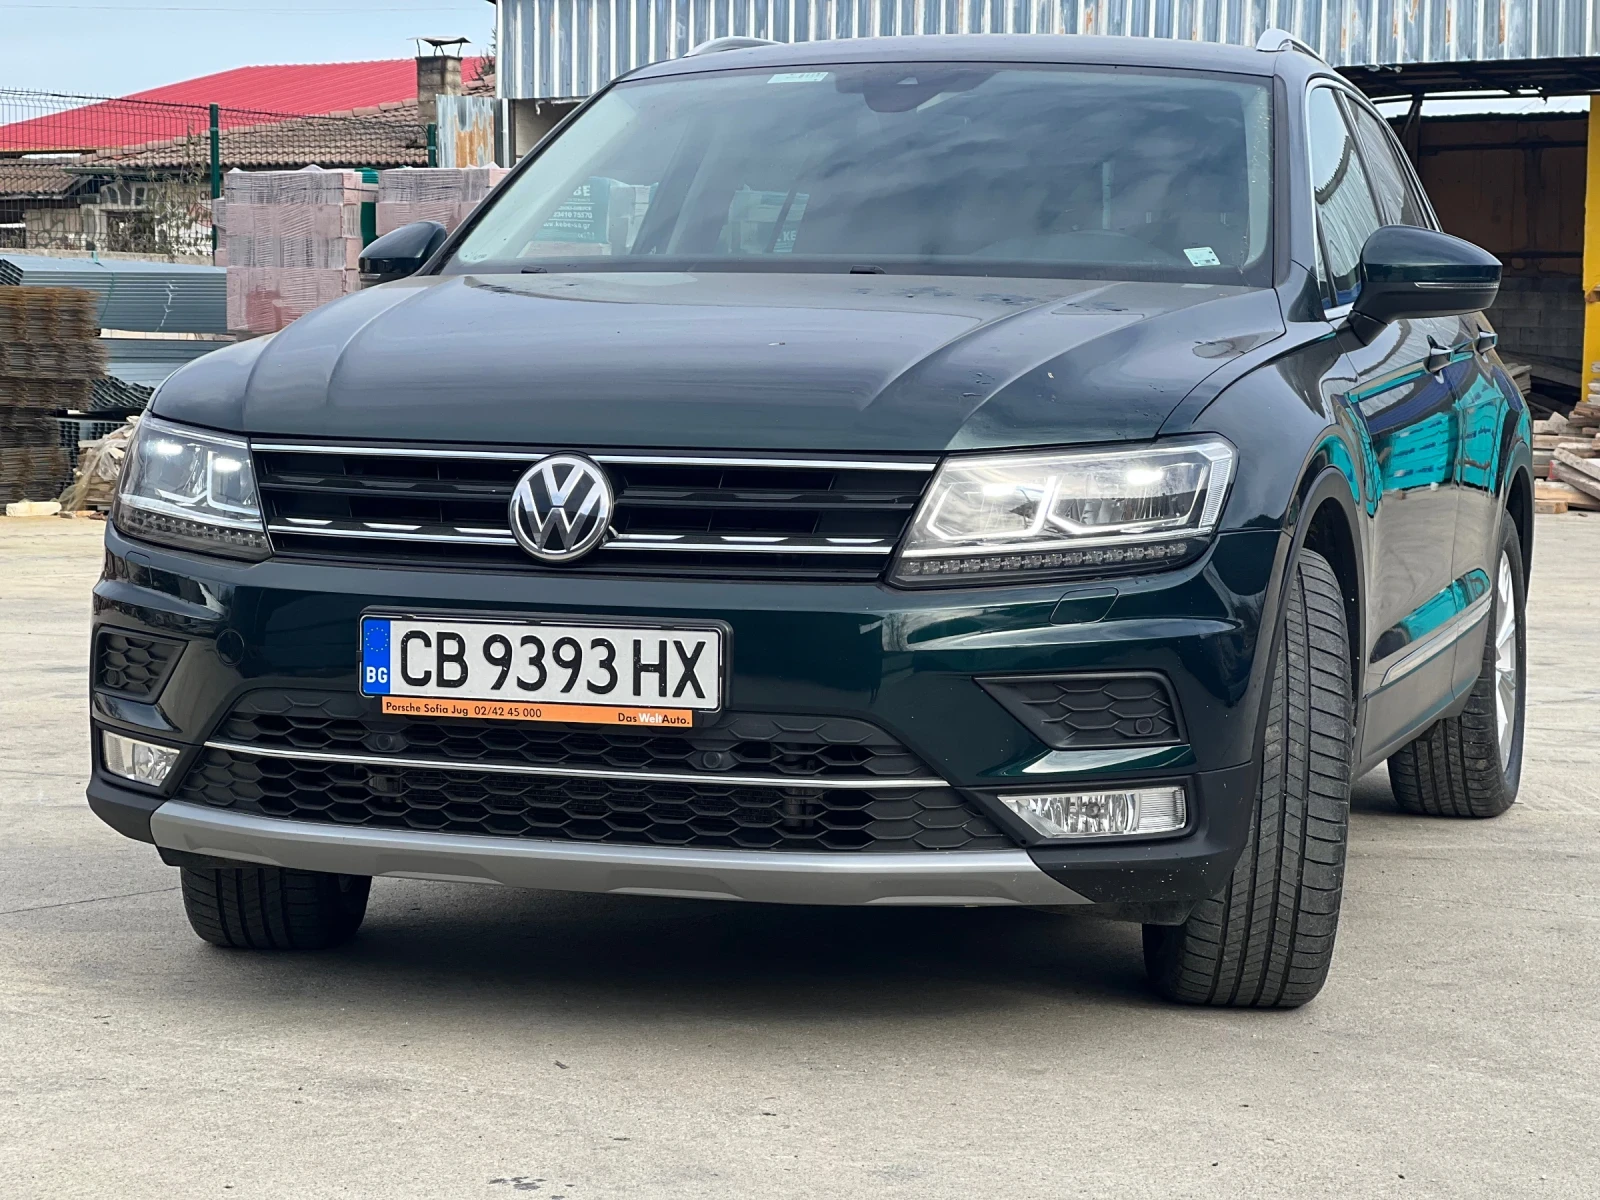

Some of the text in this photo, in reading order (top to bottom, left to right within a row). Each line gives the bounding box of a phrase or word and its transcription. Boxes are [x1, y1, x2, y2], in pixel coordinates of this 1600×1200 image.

[400, 630, 707, 699] CB 9393 HX
[366, 666, 388, 684] BG
[386, 701, 542, 718] Porsche Sofia Jug 02/42 45 000
[618, 712, 637, 723] Das
